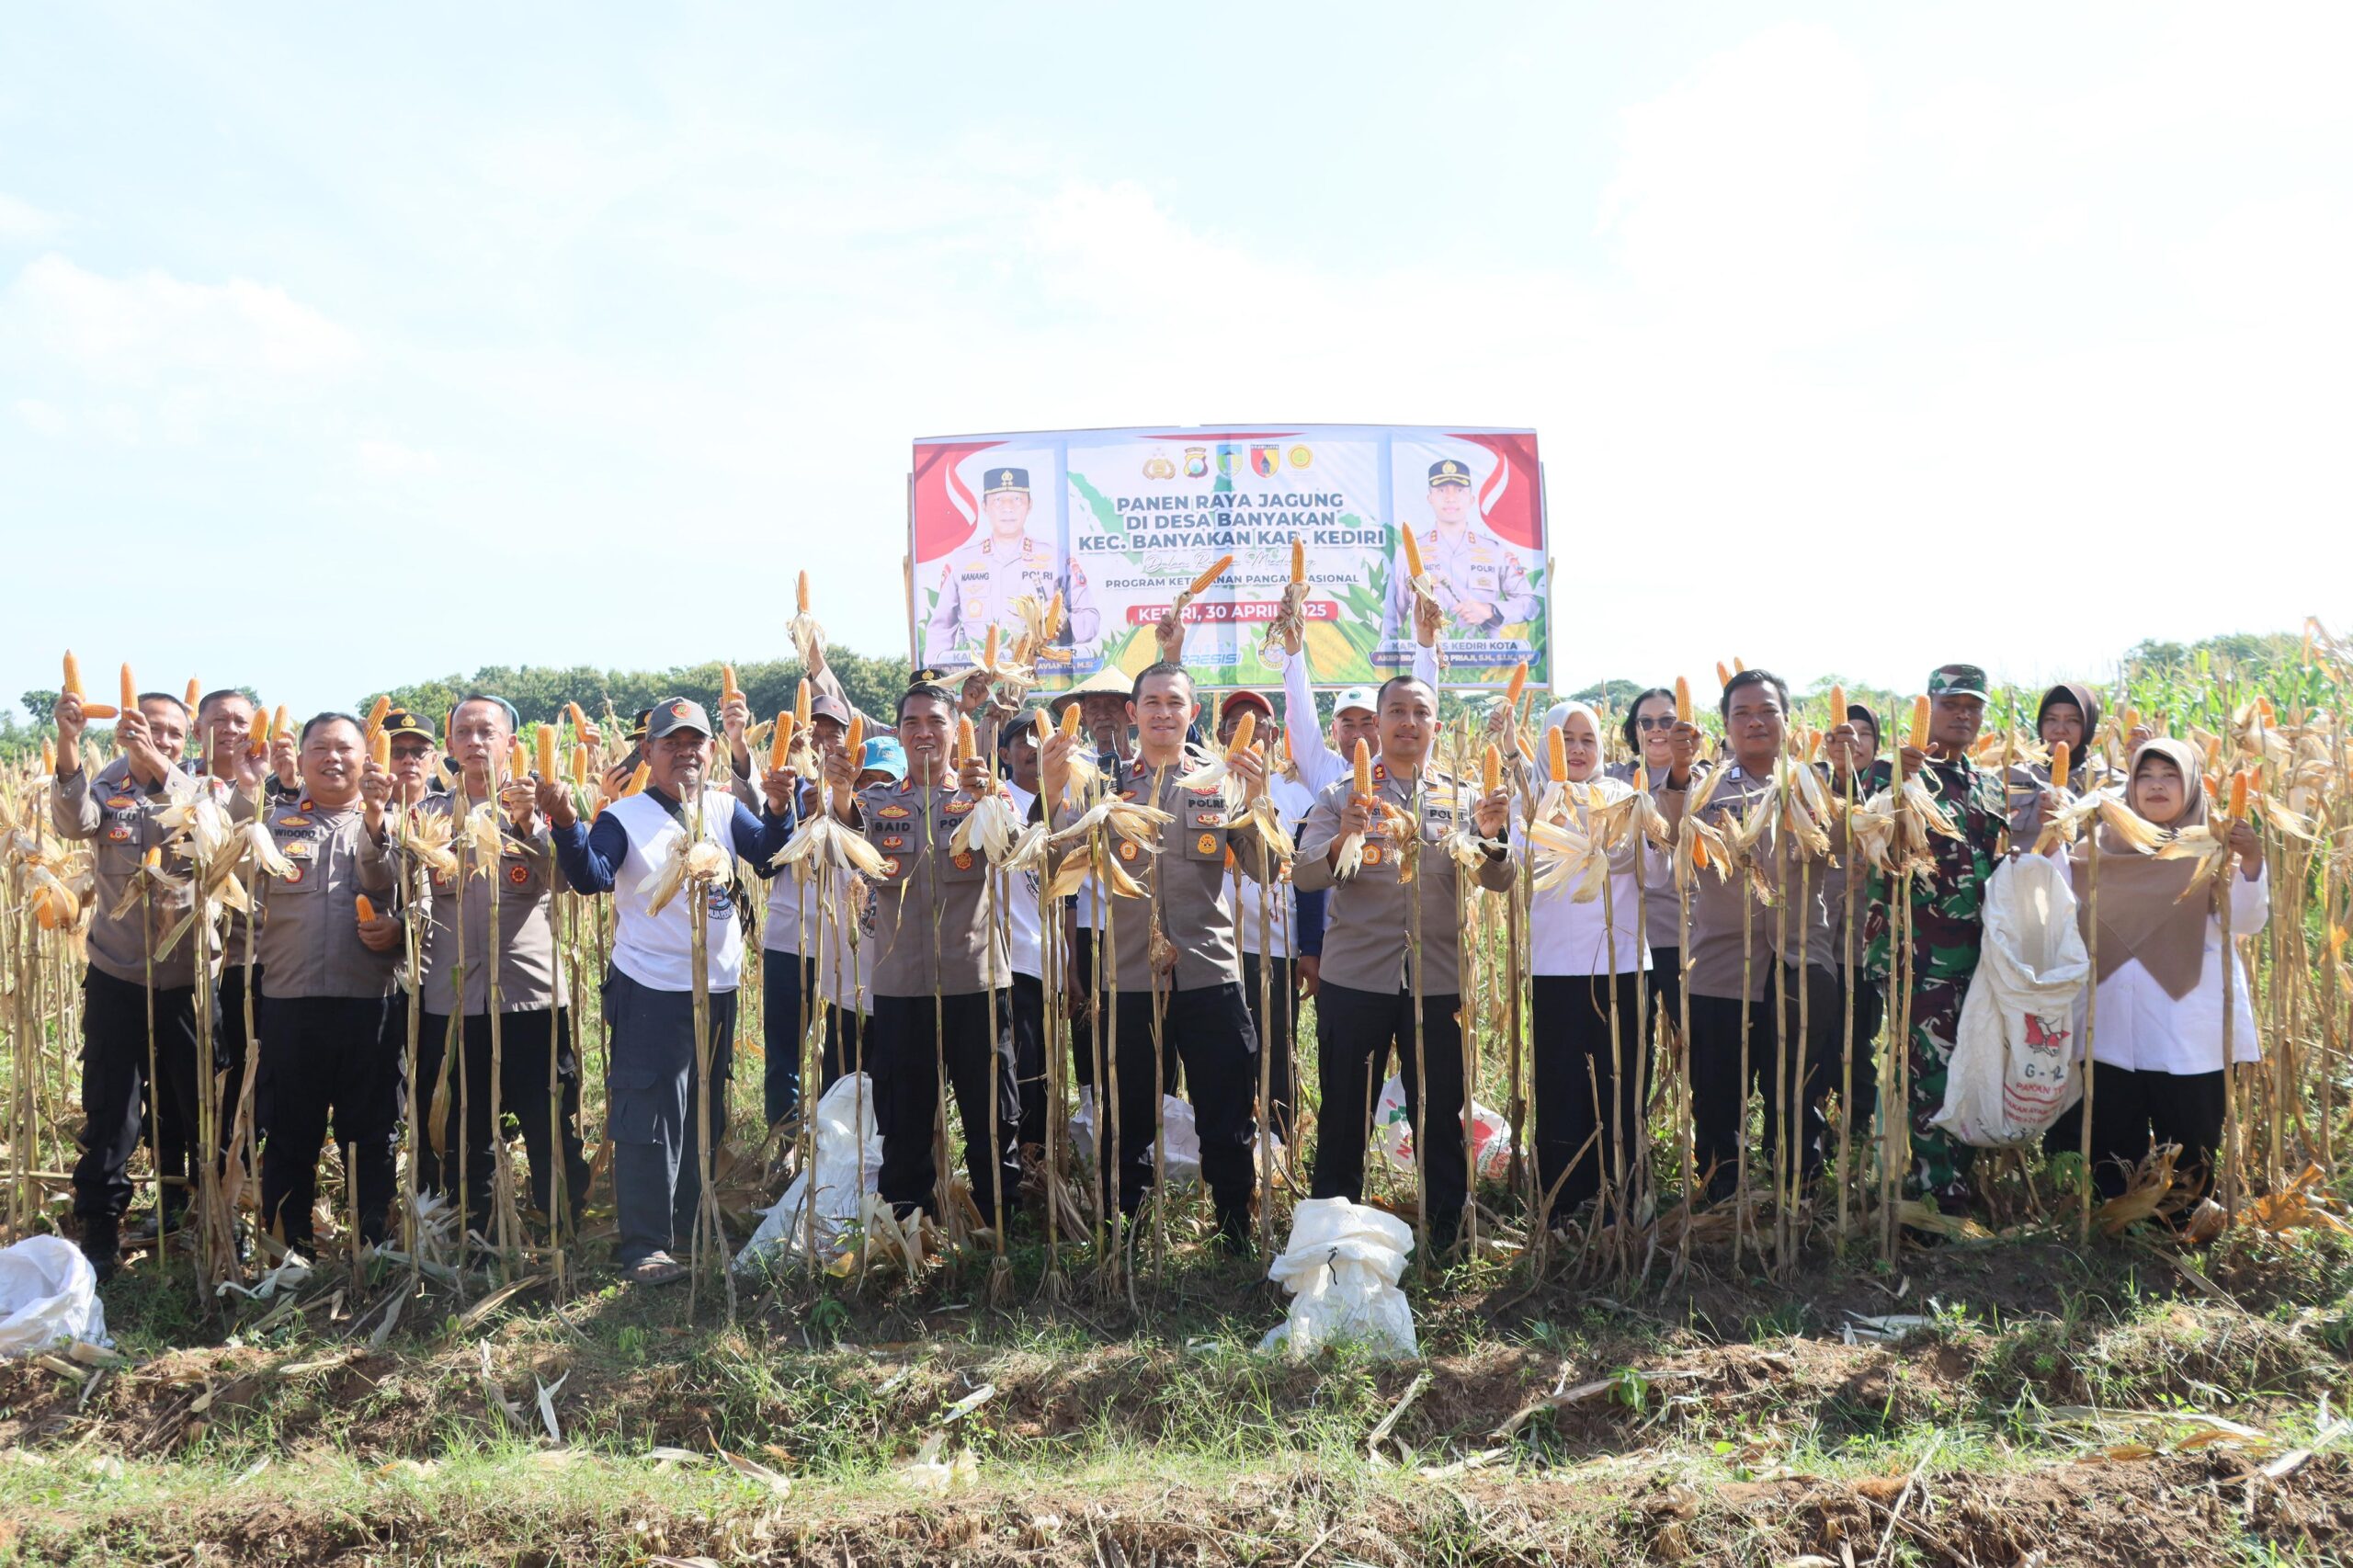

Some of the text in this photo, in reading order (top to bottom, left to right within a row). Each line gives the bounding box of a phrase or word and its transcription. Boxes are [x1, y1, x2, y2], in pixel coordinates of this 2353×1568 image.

[1117, 493, 1344, 512] PANEN RAYA JAGUNG
[1126, 511, 1336, 530] DI DESA BANYAKAN
[1078, 535, 1127, 551] KEC.
[1132, 530, 1251, 549] BANYAKAN
[1313, 529, 1383, 545] KEDIRI
[1471, 564, 1495, 573] POLRI
[961, 571, 990, 582] NANANG
[1105, 577, 1165, 588] PROGRAM
[1306, 574, 1359, 584] ASIONAL
[1206, 606, 1227, 619] 30
[1451, 641, 1487, 650] KEDIRI
[1490, 641, 1518, 650] KOTA
[1181, 653, 1243, 665] PRESISI
[1188, 798, 1224, 809] POLRI
[274, 828, 316, 839] WIDODO
